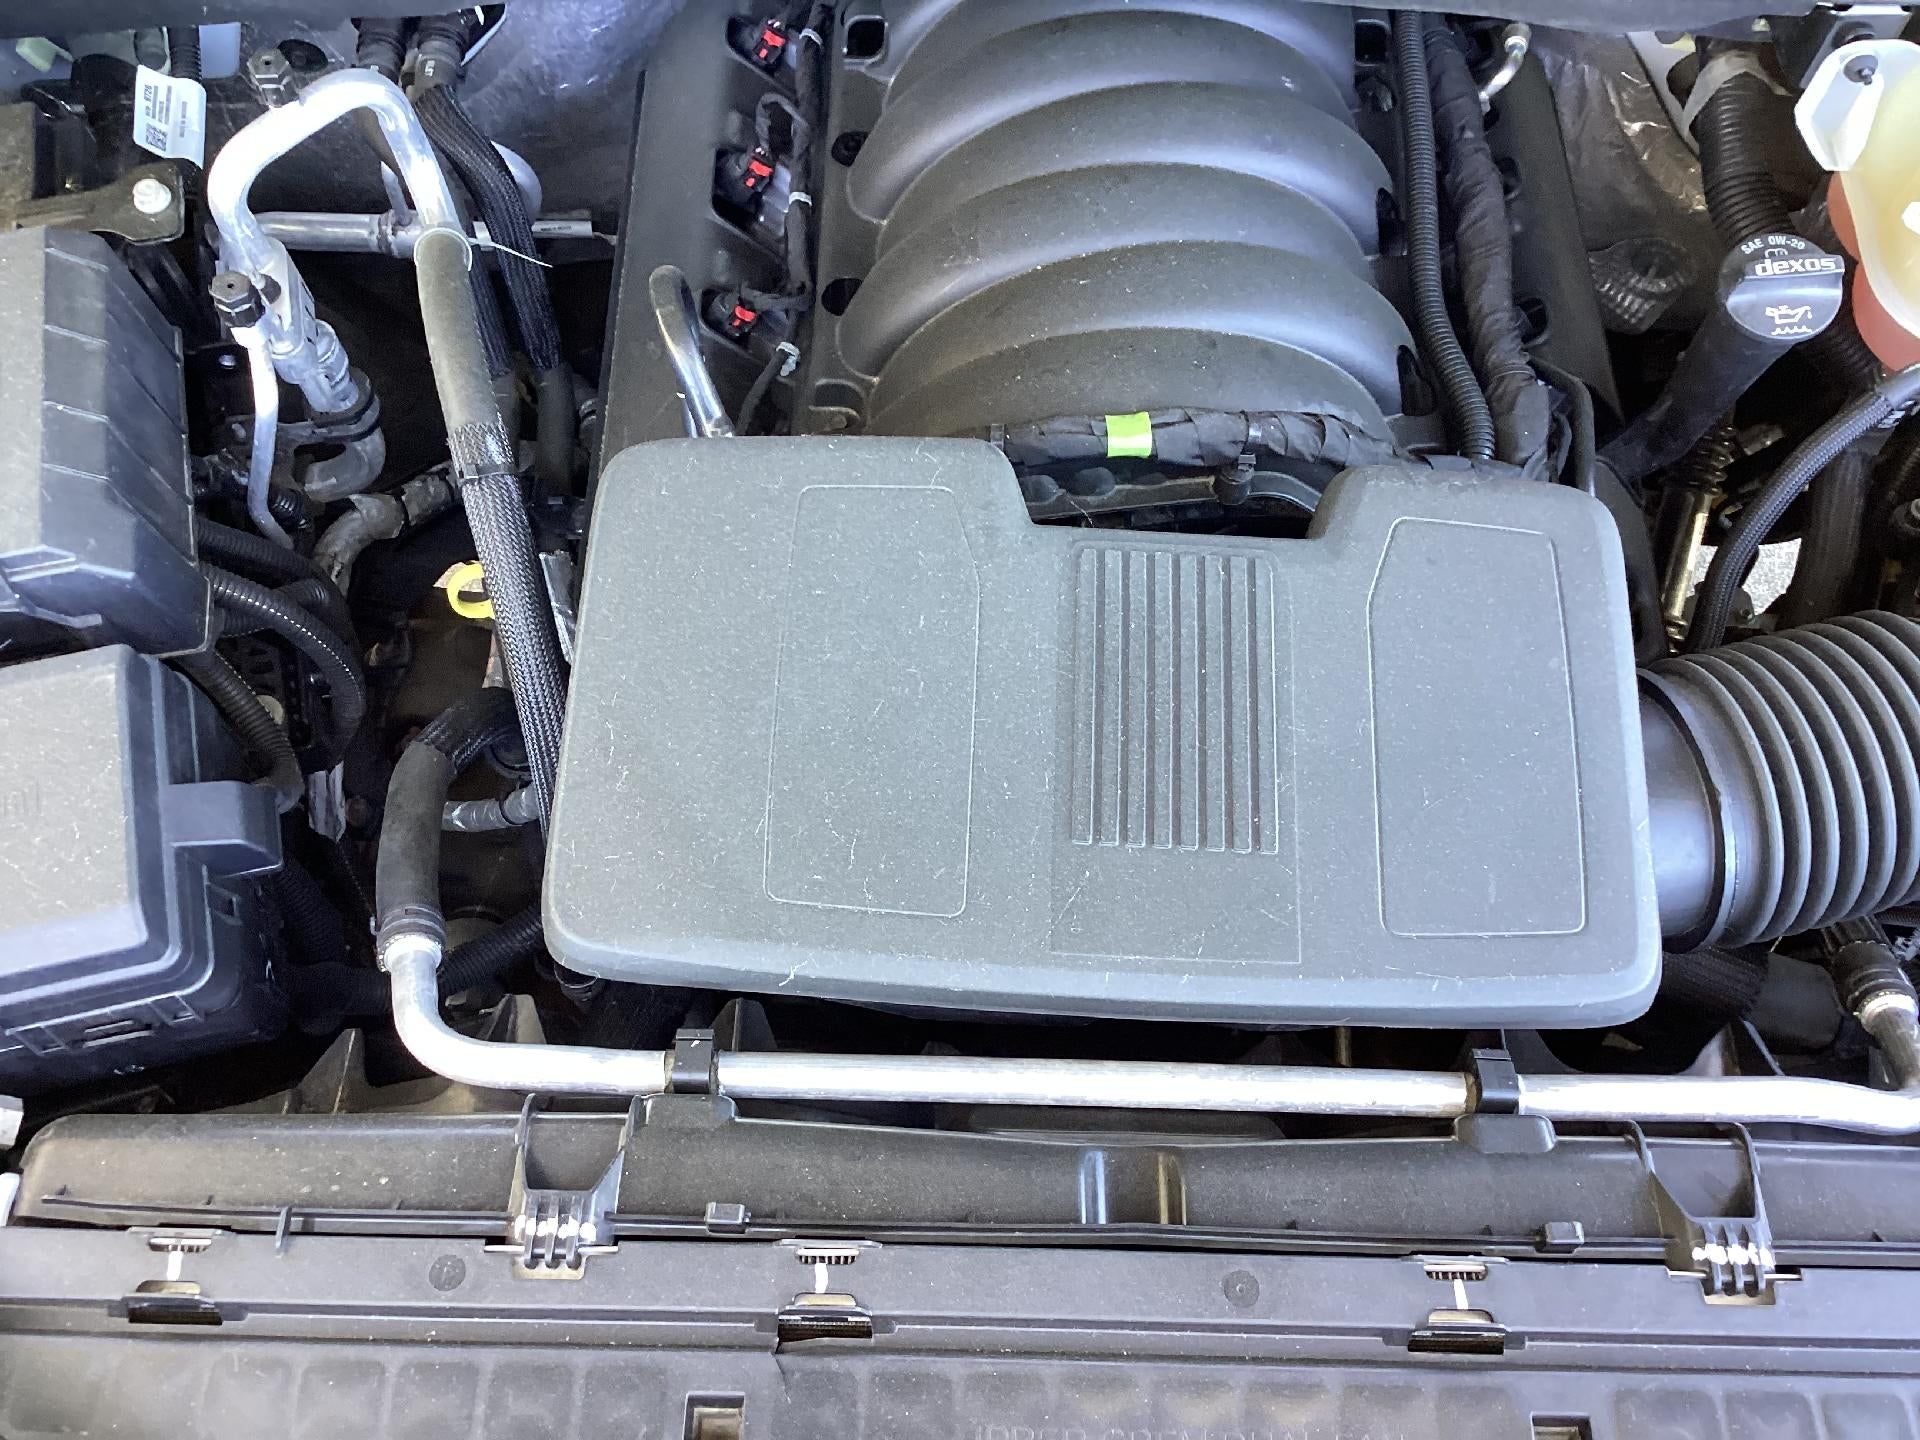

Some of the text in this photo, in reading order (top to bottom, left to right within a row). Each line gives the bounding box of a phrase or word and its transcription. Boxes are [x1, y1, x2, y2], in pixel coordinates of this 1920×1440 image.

[1741, 235, 1806, 254] SAE 0W-20
[1755, 257, 1837, 276] dexos
